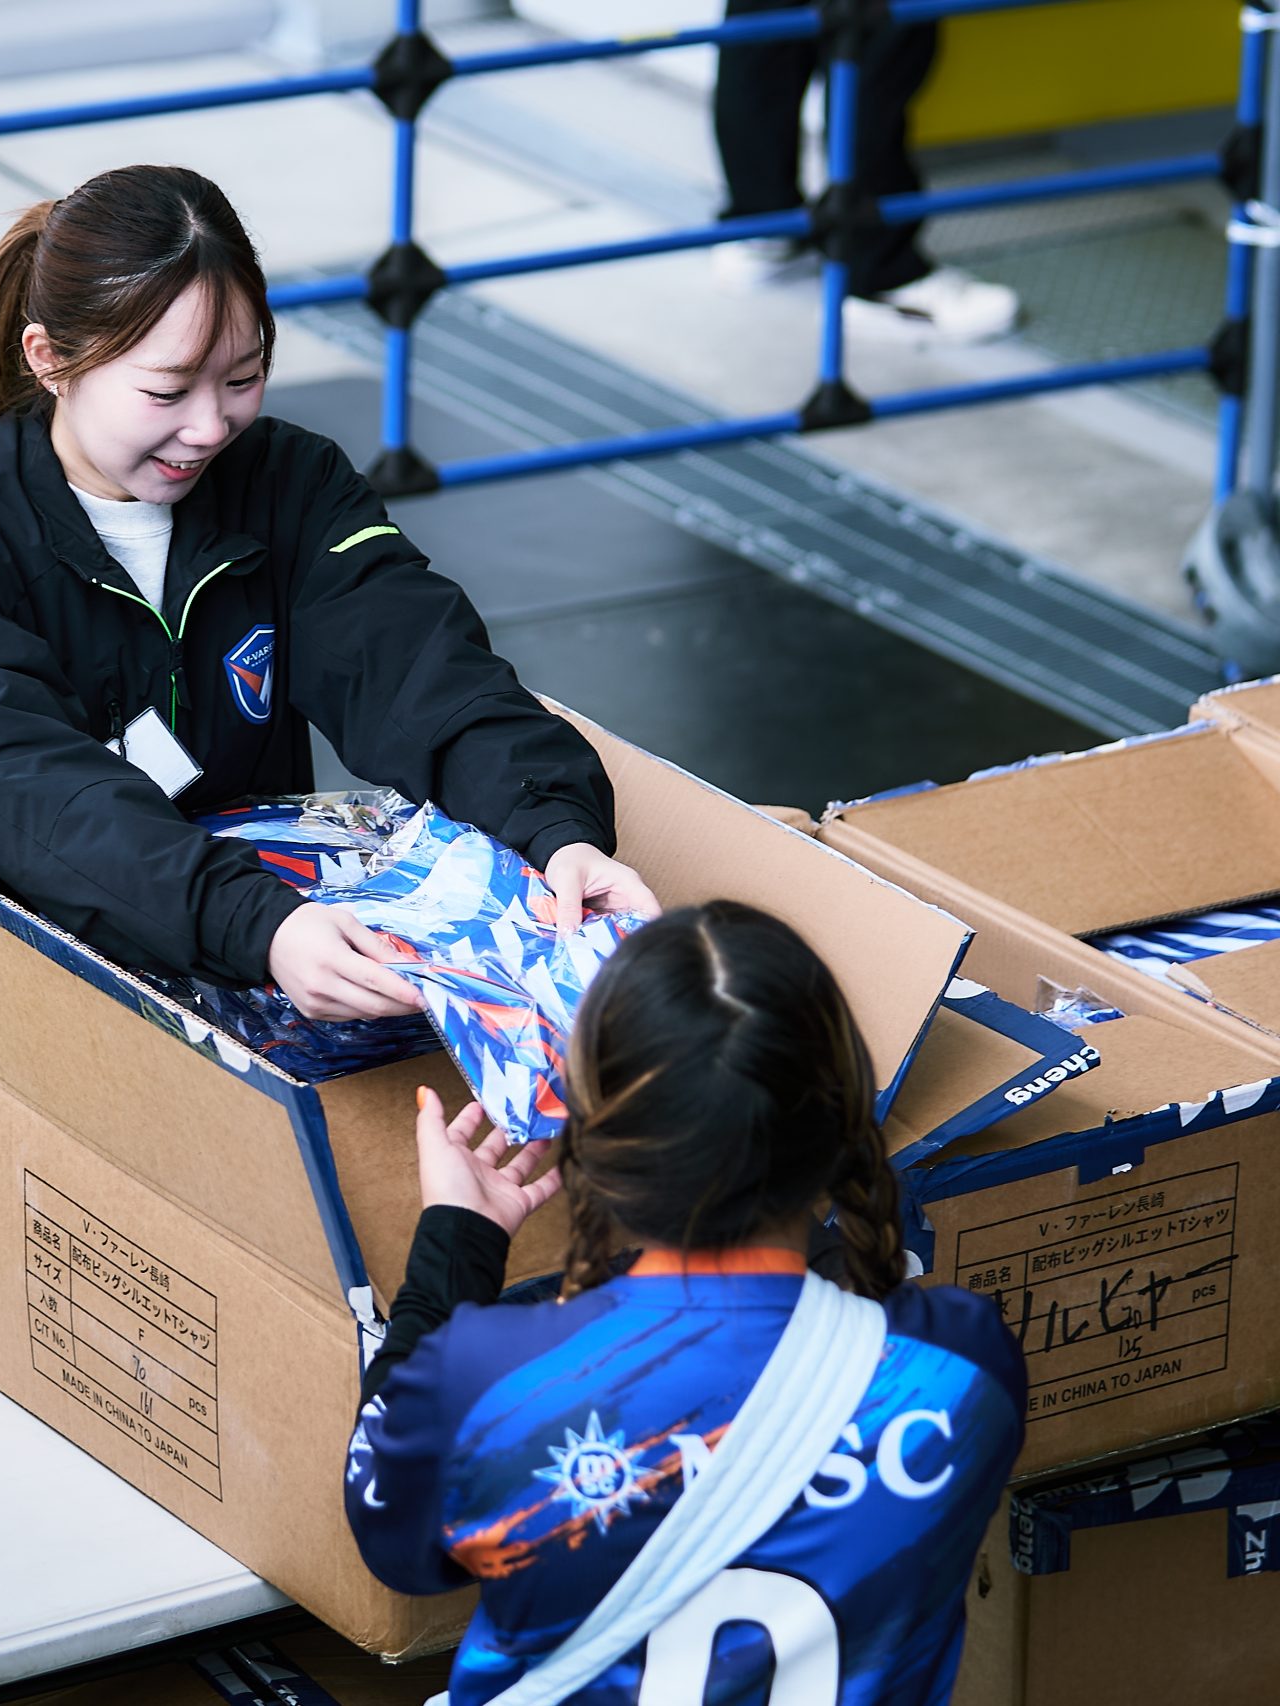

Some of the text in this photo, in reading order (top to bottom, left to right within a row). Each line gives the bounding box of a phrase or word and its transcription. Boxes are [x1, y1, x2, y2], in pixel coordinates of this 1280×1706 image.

[1004, 1045, 1101, 1106] cheng
[32, 1218, 62, 1251] 商品名
[33, 1253, 62, 1284] サイズ
[968, 1265, 1012, 1290] 商品名
[1192, 1284, 1217, 1304] pcs
[34, 1318, 70, 1353] C/T No.
[138, 1328, 145, 1341] F
[1042, 1391, 1057, 1408] IN
[1061, 1376, 1108, 1402] CHINA
[1111, 1372, 1130, 1389] TO
[1134, 1358, 1183, 1385] JAPAN
[62, 1368, 189, 1468] MADE IN CHINA TO JAPAN
[188, 1397, 208, 1416] pcs
